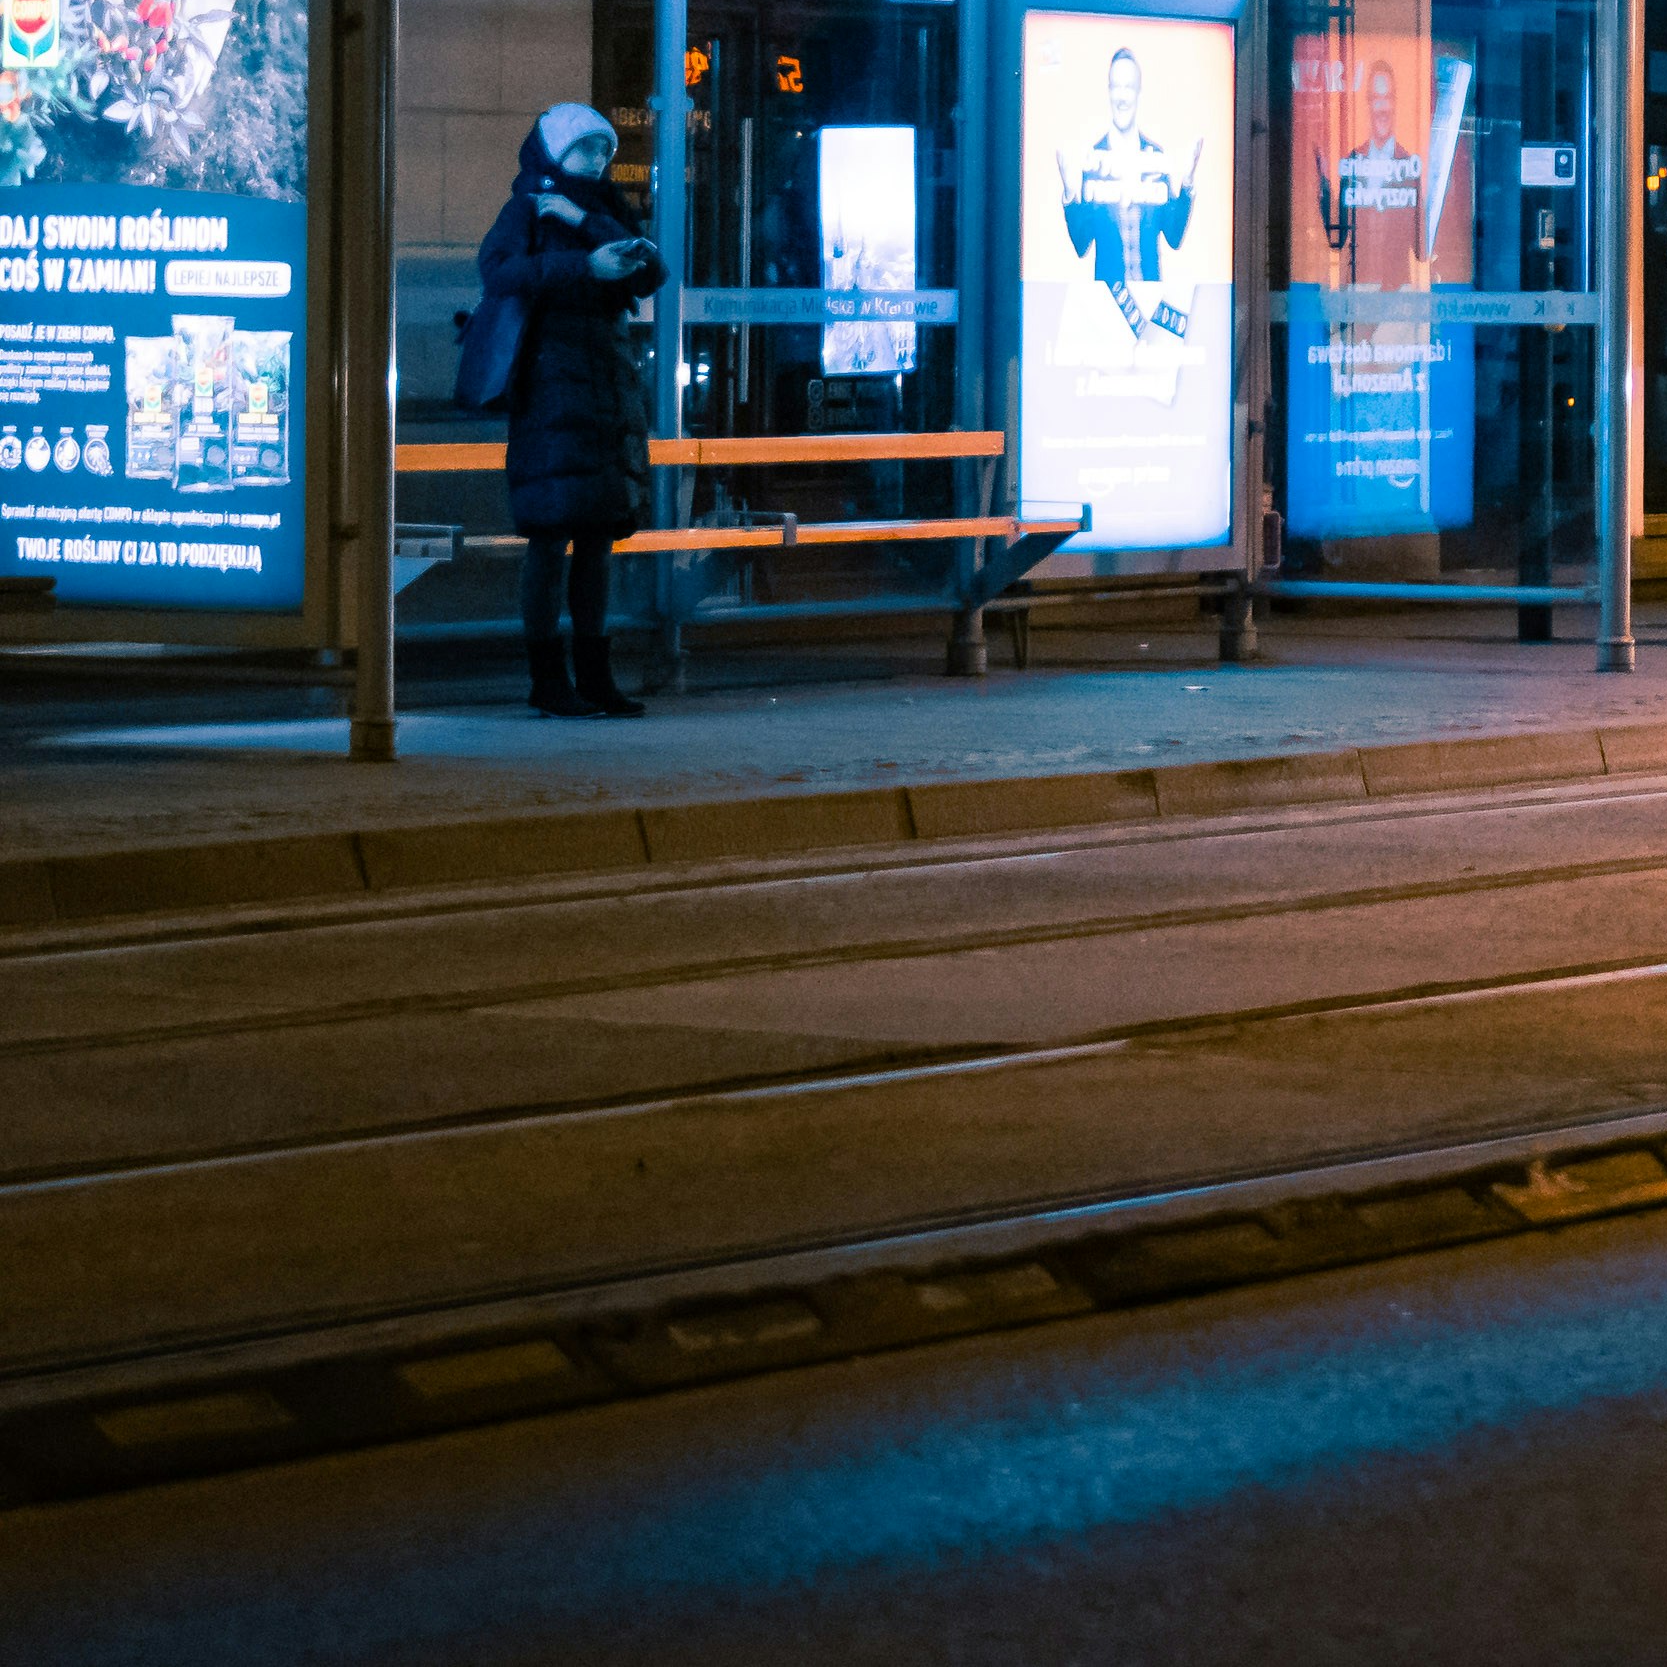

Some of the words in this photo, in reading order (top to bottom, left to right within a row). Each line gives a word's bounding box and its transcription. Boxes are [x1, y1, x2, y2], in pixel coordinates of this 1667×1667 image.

[43, 215, 116, 250] SWOIM
[120, 208, 228, 252] ROŚLINOM
[0, 250, 39, 292] COŚ
[43, 258, 64, 292] W
[68, 258, 156, 294] ZAMIAN!
[173, 269, 211, 286] LEPIEJ
[215, 270, 279, 288] NAJLEPSZE
[1, 503, 35, 519] Sprawdź
[104, 506, 132, 522] COMPO
[17, 536, 61, 561] TWOJE
[63, 534, 121, 563] ROŚLINY
[122, 540, 138, 565] CI
[139, 541, 157, 565] ZA
[159, 541, 178, 566] TO
[179, 542, 262, 573] PODZIĘKUJĄ
